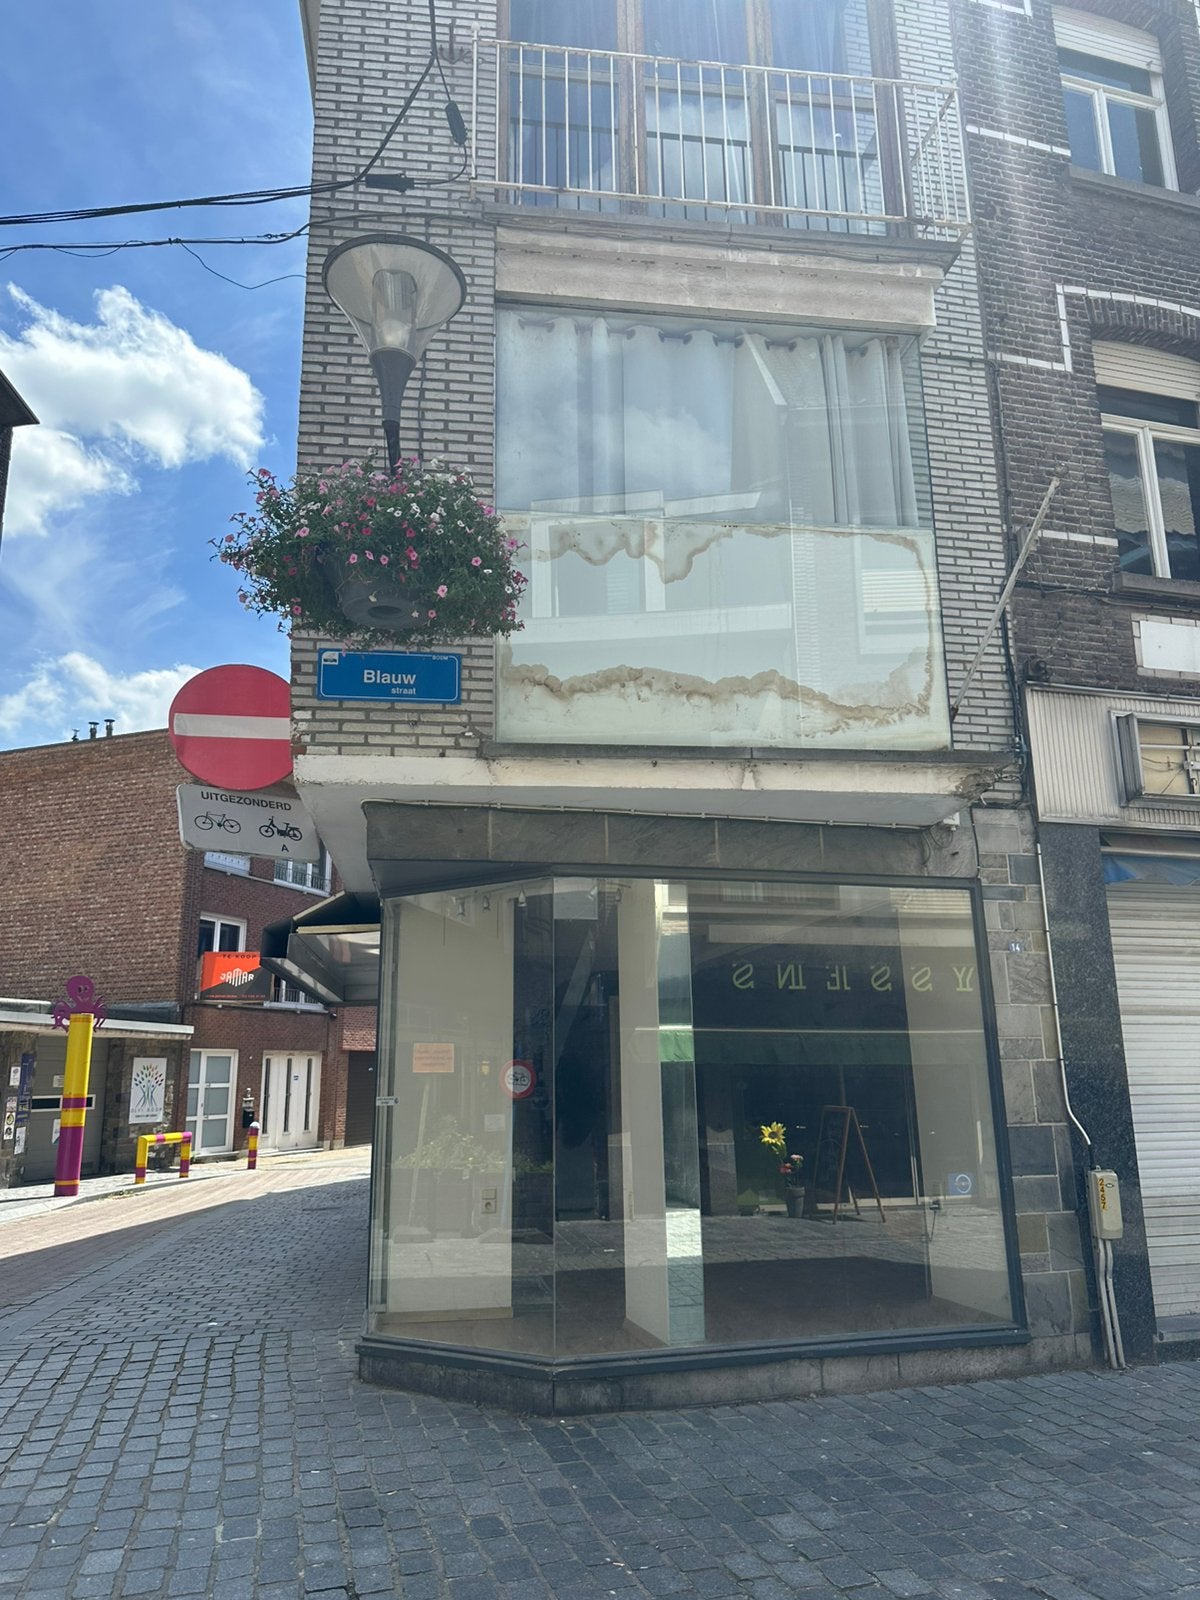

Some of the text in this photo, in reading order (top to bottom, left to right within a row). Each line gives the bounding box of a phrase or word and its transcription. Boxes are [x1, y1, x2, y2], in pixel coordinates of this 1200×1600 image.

[363, 669, 417, 684] Blauw
[391, 686, 417, 695] straat
[201, 791, 292, 811] UITGEZONDERD
[281, 844, 289, 852] A
[220, 968, 255, 987] JAMAR
